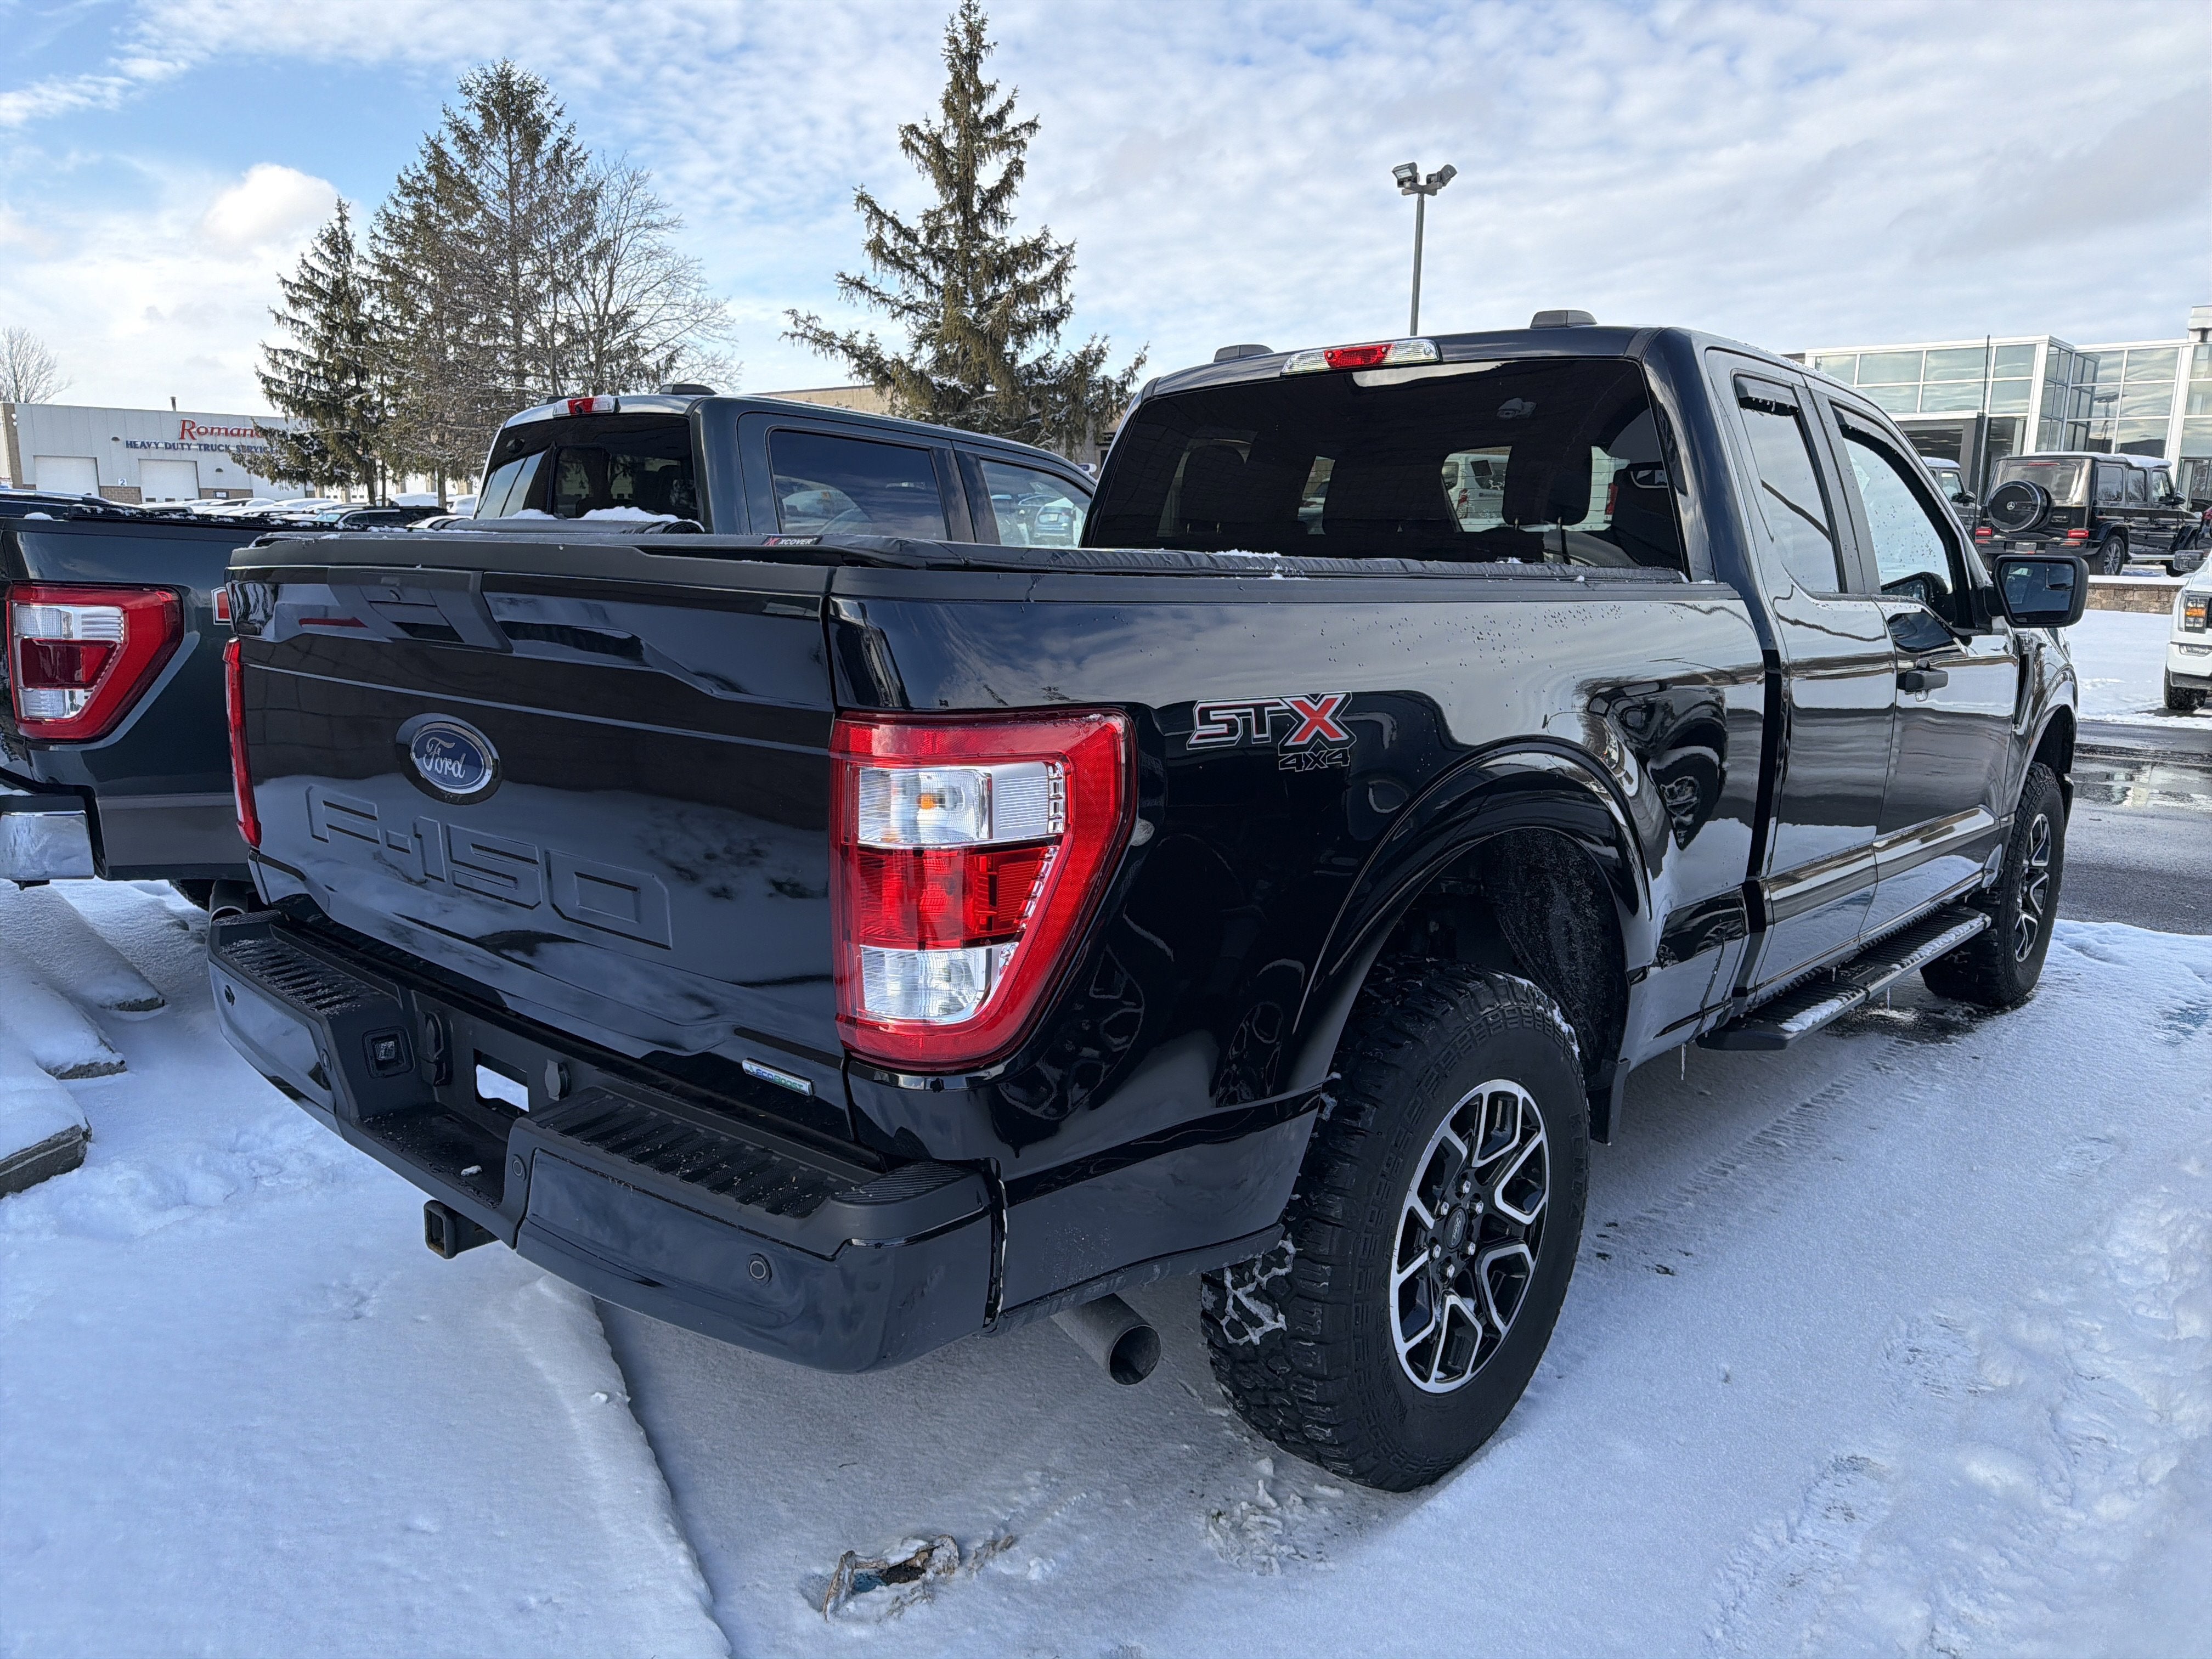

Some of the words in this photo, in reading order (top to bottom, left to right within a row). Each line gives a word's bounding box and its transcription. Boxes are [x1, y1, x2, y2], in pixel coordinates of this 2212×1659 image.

[126, 440, 160, 450] HEAVY
[164, 442, 193, 451] DUTY
[197, 443, 231, 452] TRUCK
[1187, 691, 1355, 751] STX
[423, 736, 466, 778] Ford
[305, 784, 673, 950] F-150
[1568, 1112, 1585, 1220] KENDA
